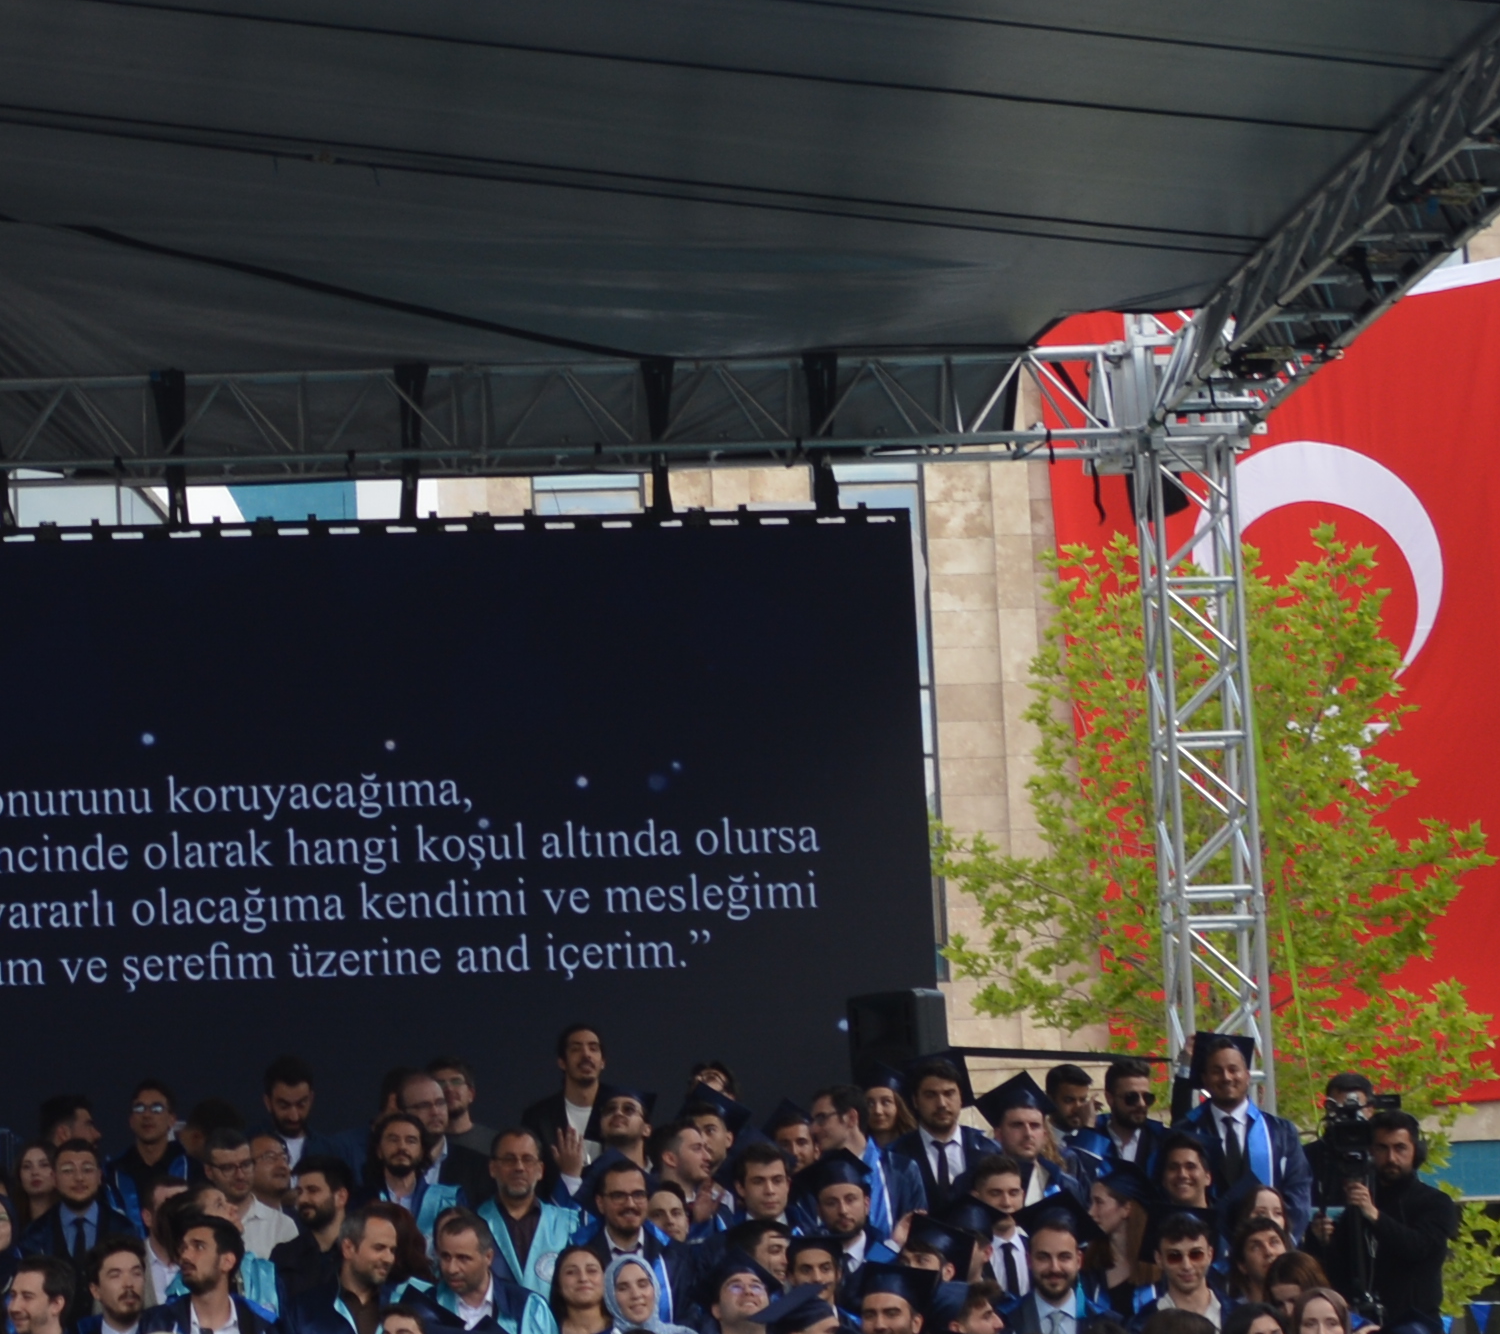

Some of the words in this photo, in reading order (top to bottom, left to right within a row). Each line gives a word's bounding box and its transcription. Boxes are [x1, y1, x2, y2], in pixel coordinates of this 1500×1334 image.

[168, 773, 472, 821] koruyacağıma,
[144, 829, 272, 869] olarak
[288, 825, 398, 874] hangi
[417, 820, 525, 870] koşul
[542, 819, 681, 858] altında
[696, 817, 819, 855] olursa
[132, 887, 345, 933] olacağıma
[360, 878, 526, 919] kendimi
[543, 888, 589, 914] ve
[606, 870, 817, 920] mesleğimi
[60, 958, 107, 983] ve
[123, 942, 274, 991] şerefim
[290, 938, 440, 977] üzerine
[457, 934, 529, 973] and
